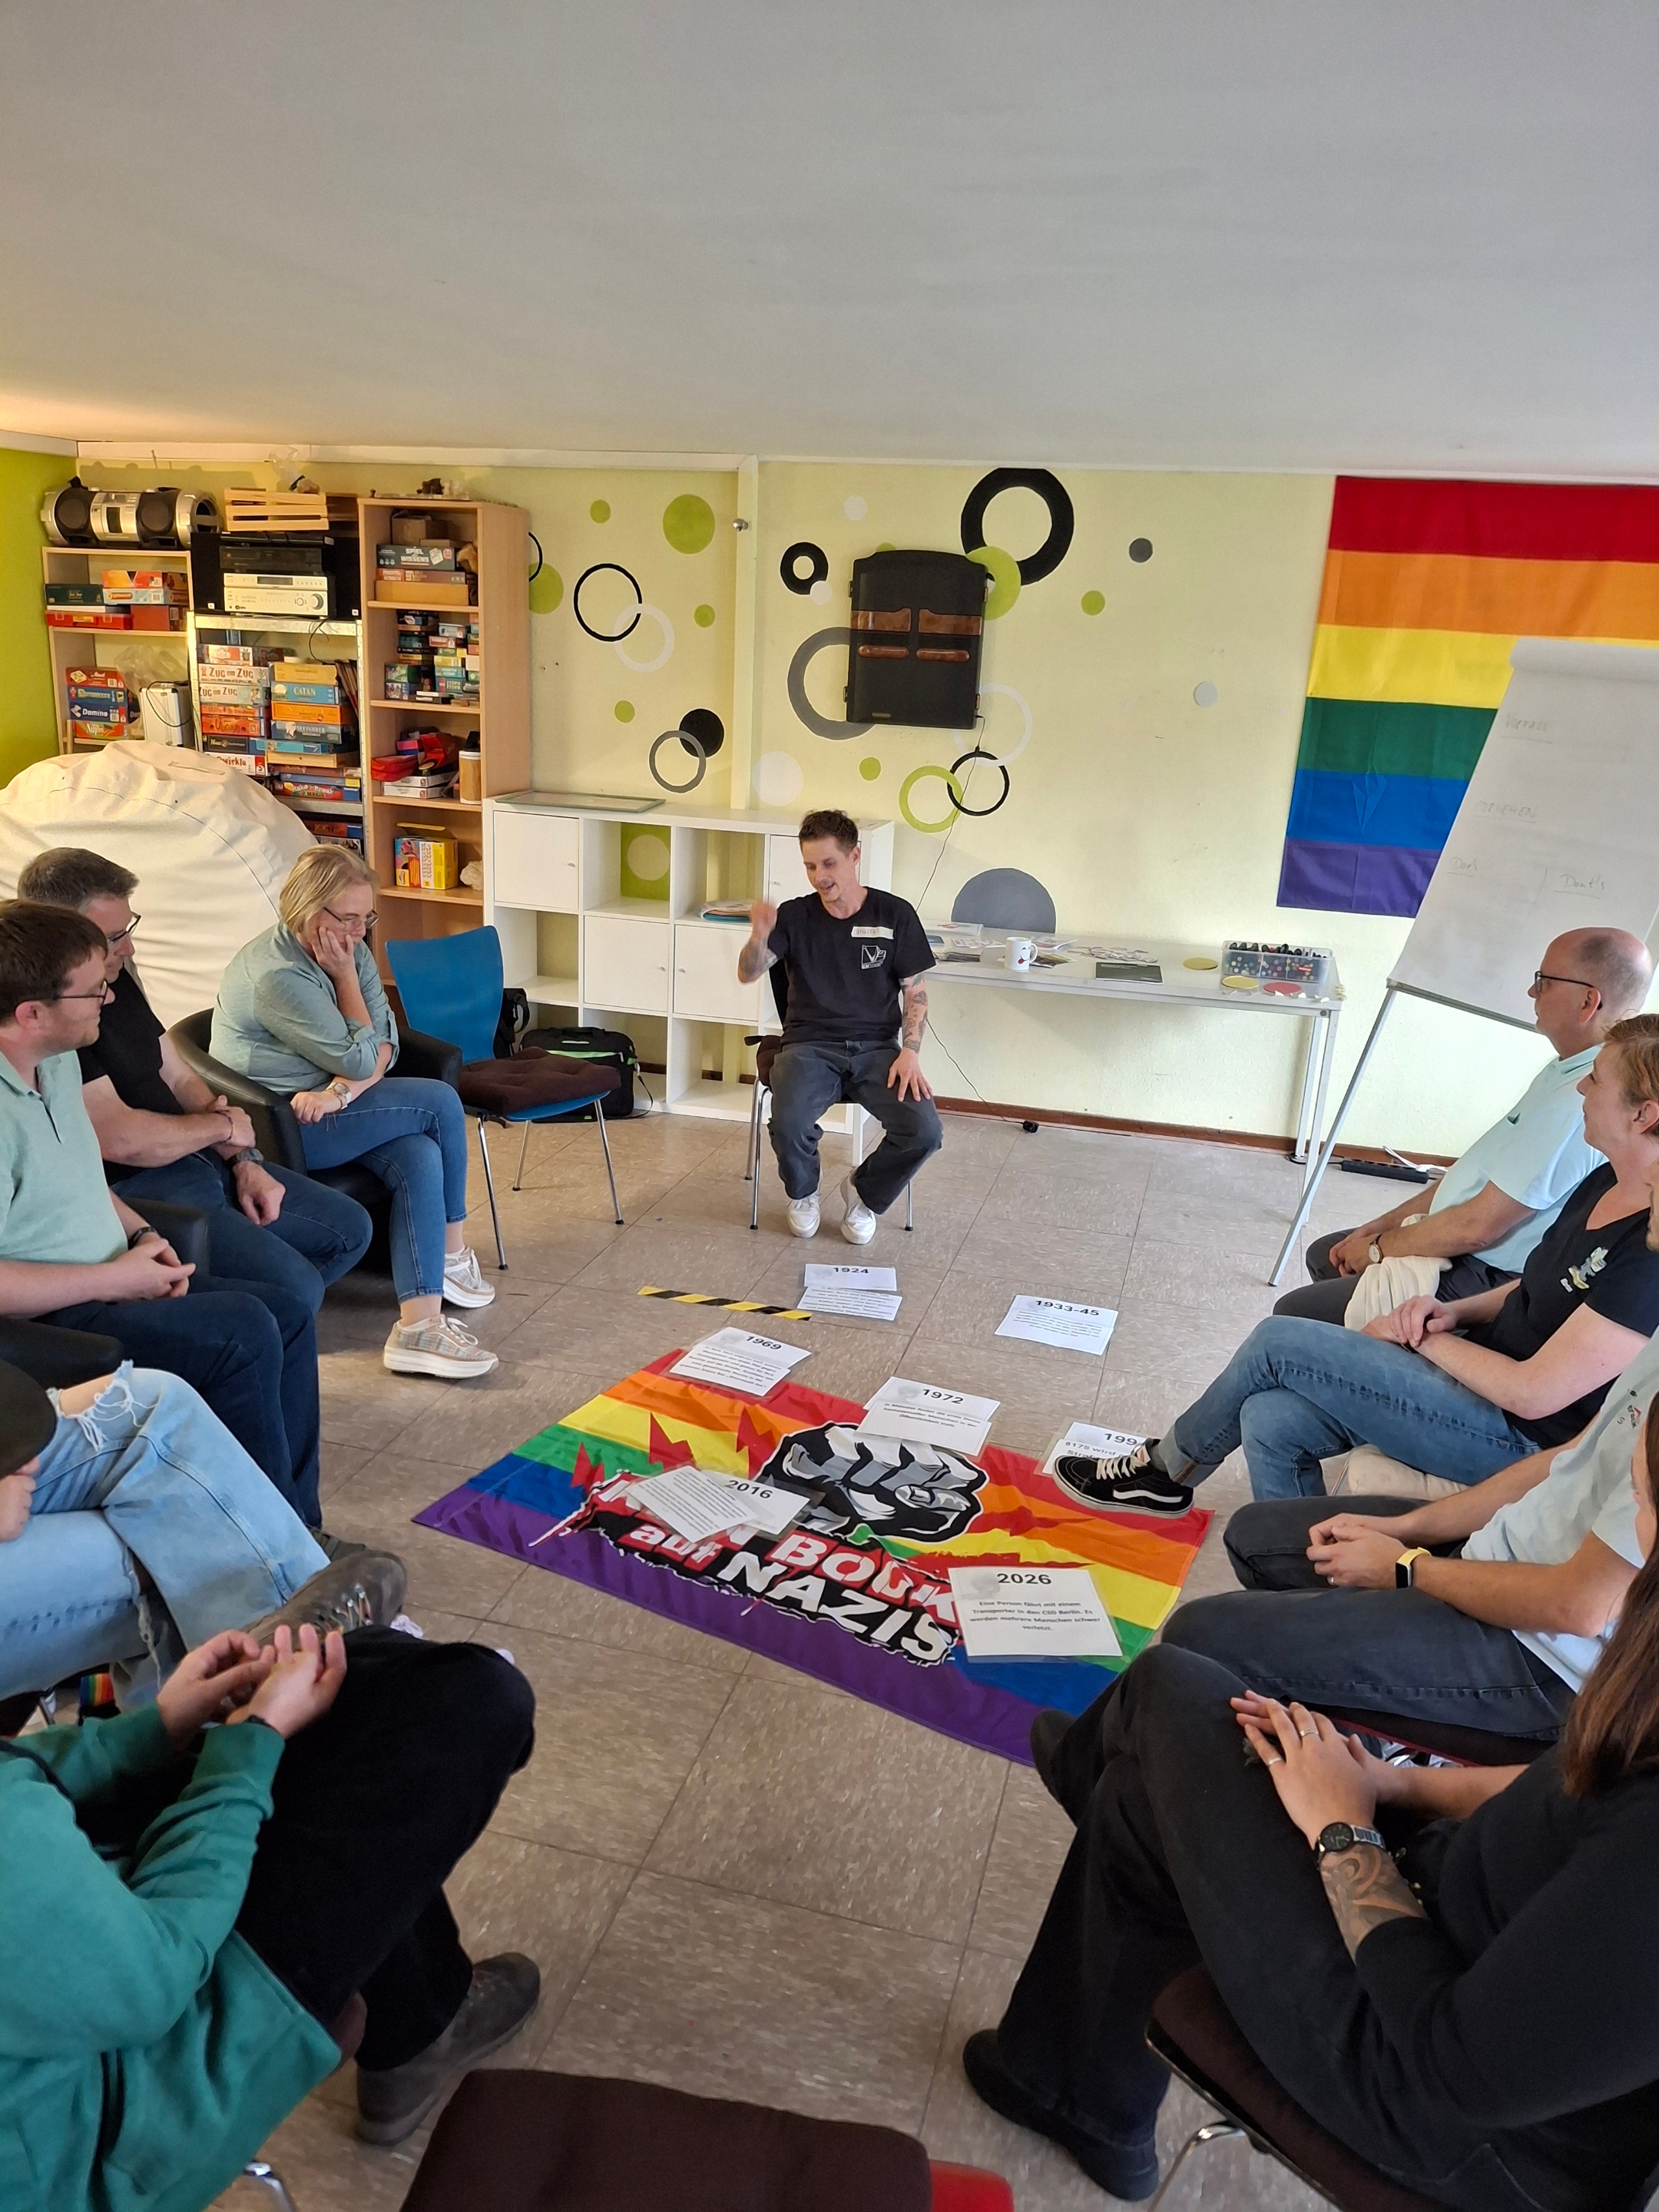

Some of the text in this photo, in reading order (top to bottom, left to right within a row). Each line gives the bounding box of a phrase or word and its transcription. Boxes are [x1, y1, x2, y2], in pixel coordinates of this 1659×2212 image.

[293, 687, 316, 697] CATAN
[82, 708, 108, 717] Domino
[1035, 1300, 1099, 1316] 1933-45
[746, 1336, 782, 1350] 1969
[922, 1389, 965, 1405] 1972
[1104, 1433, 1138, 1445] 199
[1092, 1447, 1116, 1456] wird
[725, 1480, 773, 1498] 2016
[997, 1573, 1052, 1584] 2026
[717, 1551, 952, 1661] NAZIS
